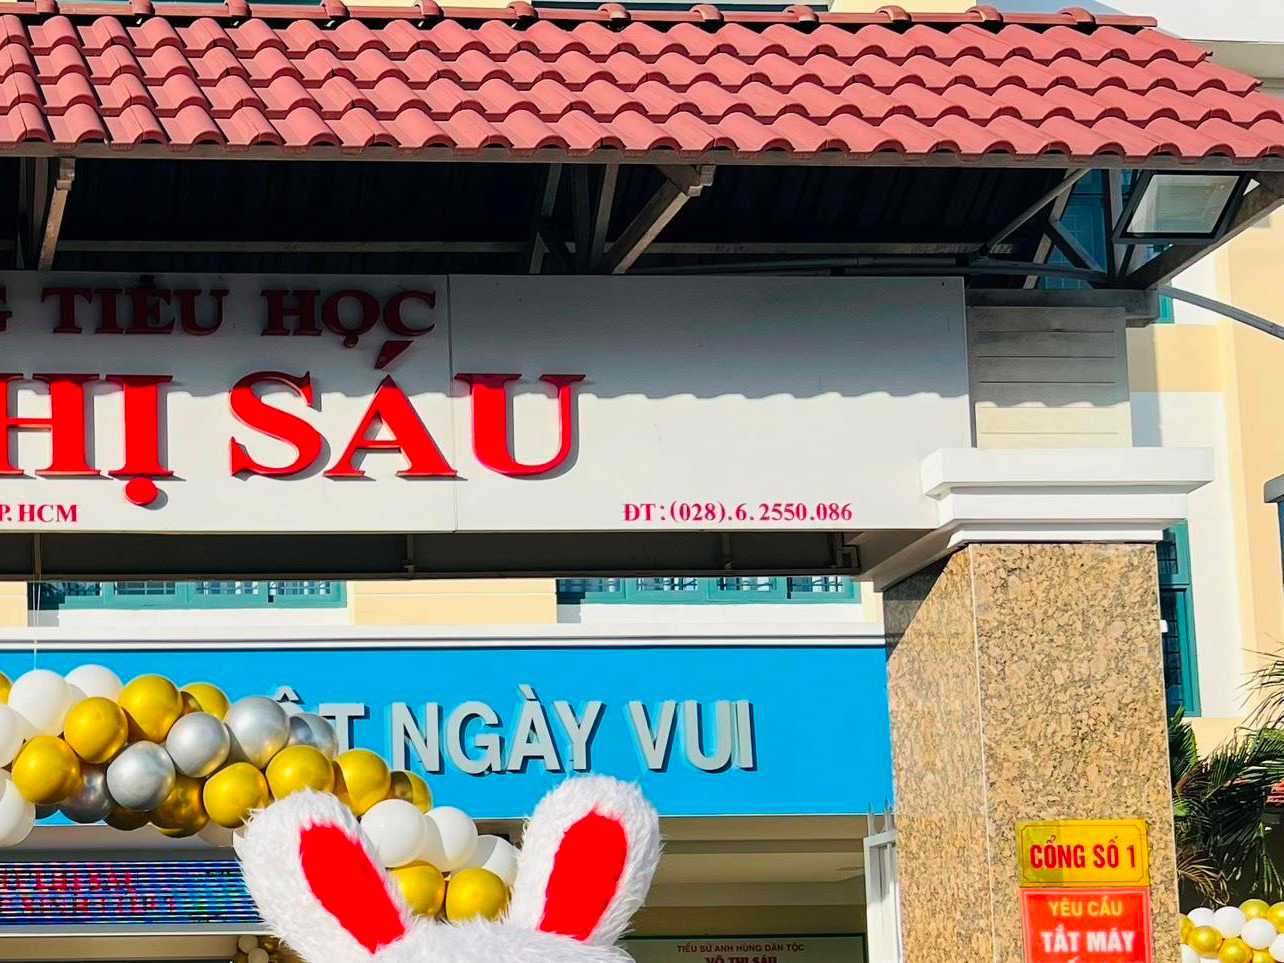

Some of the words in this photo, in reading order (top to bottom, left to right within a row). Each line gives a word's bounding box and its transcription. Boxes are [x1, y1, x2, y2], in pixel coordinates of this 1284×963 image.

[42, 275, 229, 335] TIỂU
[261, 289, 437, 348] HỌC
[229, 340, 587, 478] SÁU
[392, 683, 604, 774] NGÀY
[630, 700, 755, 771] VUI
[1029, 834, 1086, 869] CỔNG
[1093, 836, 1119, 869] SỐ
[1126, 845, 1136, 868] 1
[1048, 897, 1083, 917] YÊU
[1087, 895, 1123, 917] CẦU
[715, 944, 733, 952] ANH
[1041, 924, 1081, 953] TẮT
[1086, 927, 1134, 953] MÁY
